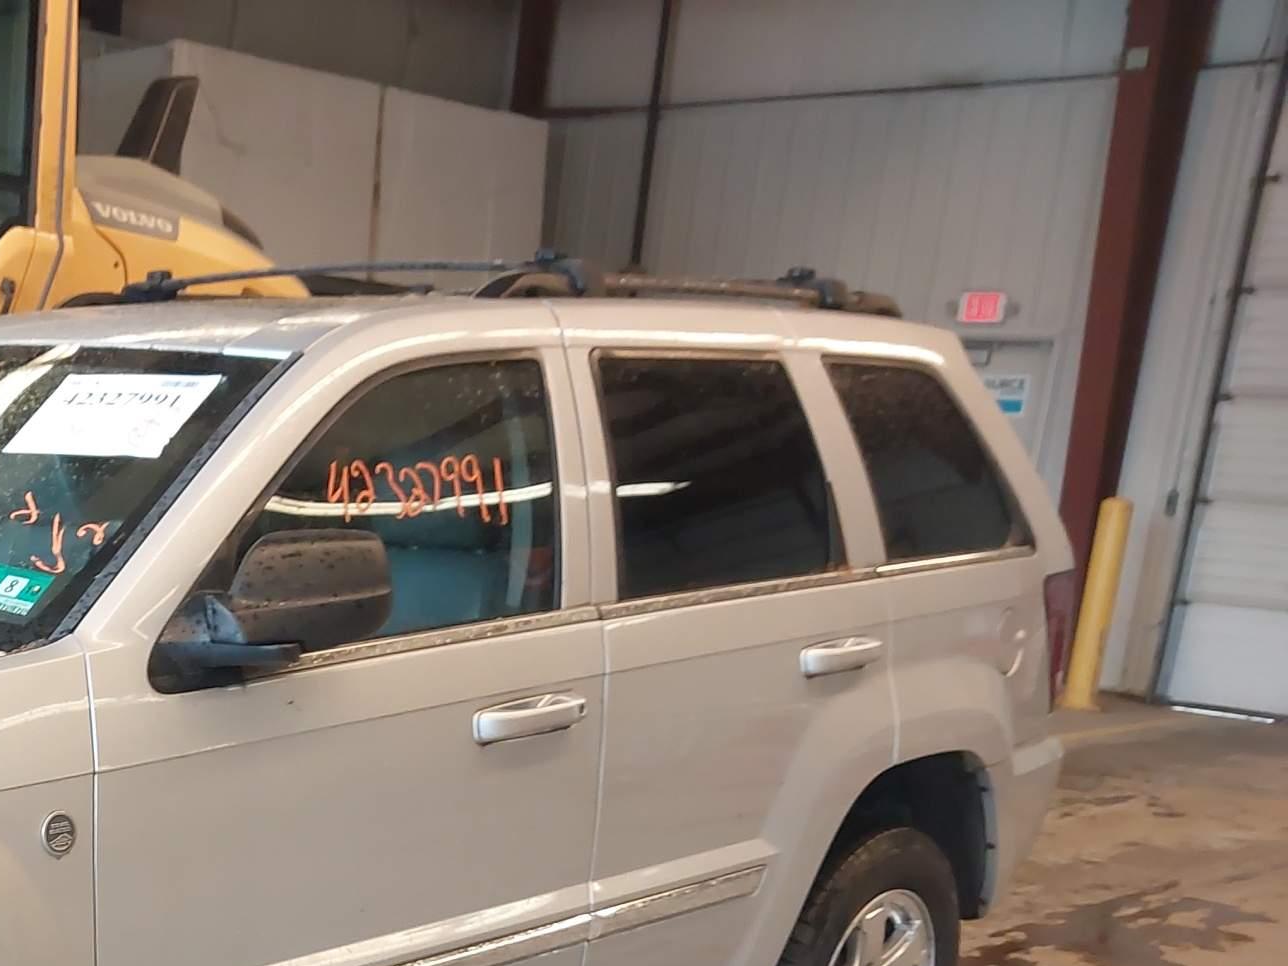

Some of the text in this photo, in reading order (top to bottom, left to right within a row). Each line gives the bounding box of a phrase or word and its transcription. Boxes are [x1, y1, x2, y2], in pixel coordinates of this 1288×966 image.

[91, 201, 173, 233] VOLVO
[63, 391, 182, 409] 42327991
[326, 453, 509, 526] 42327991
[4, 579, 19, 593] 8
